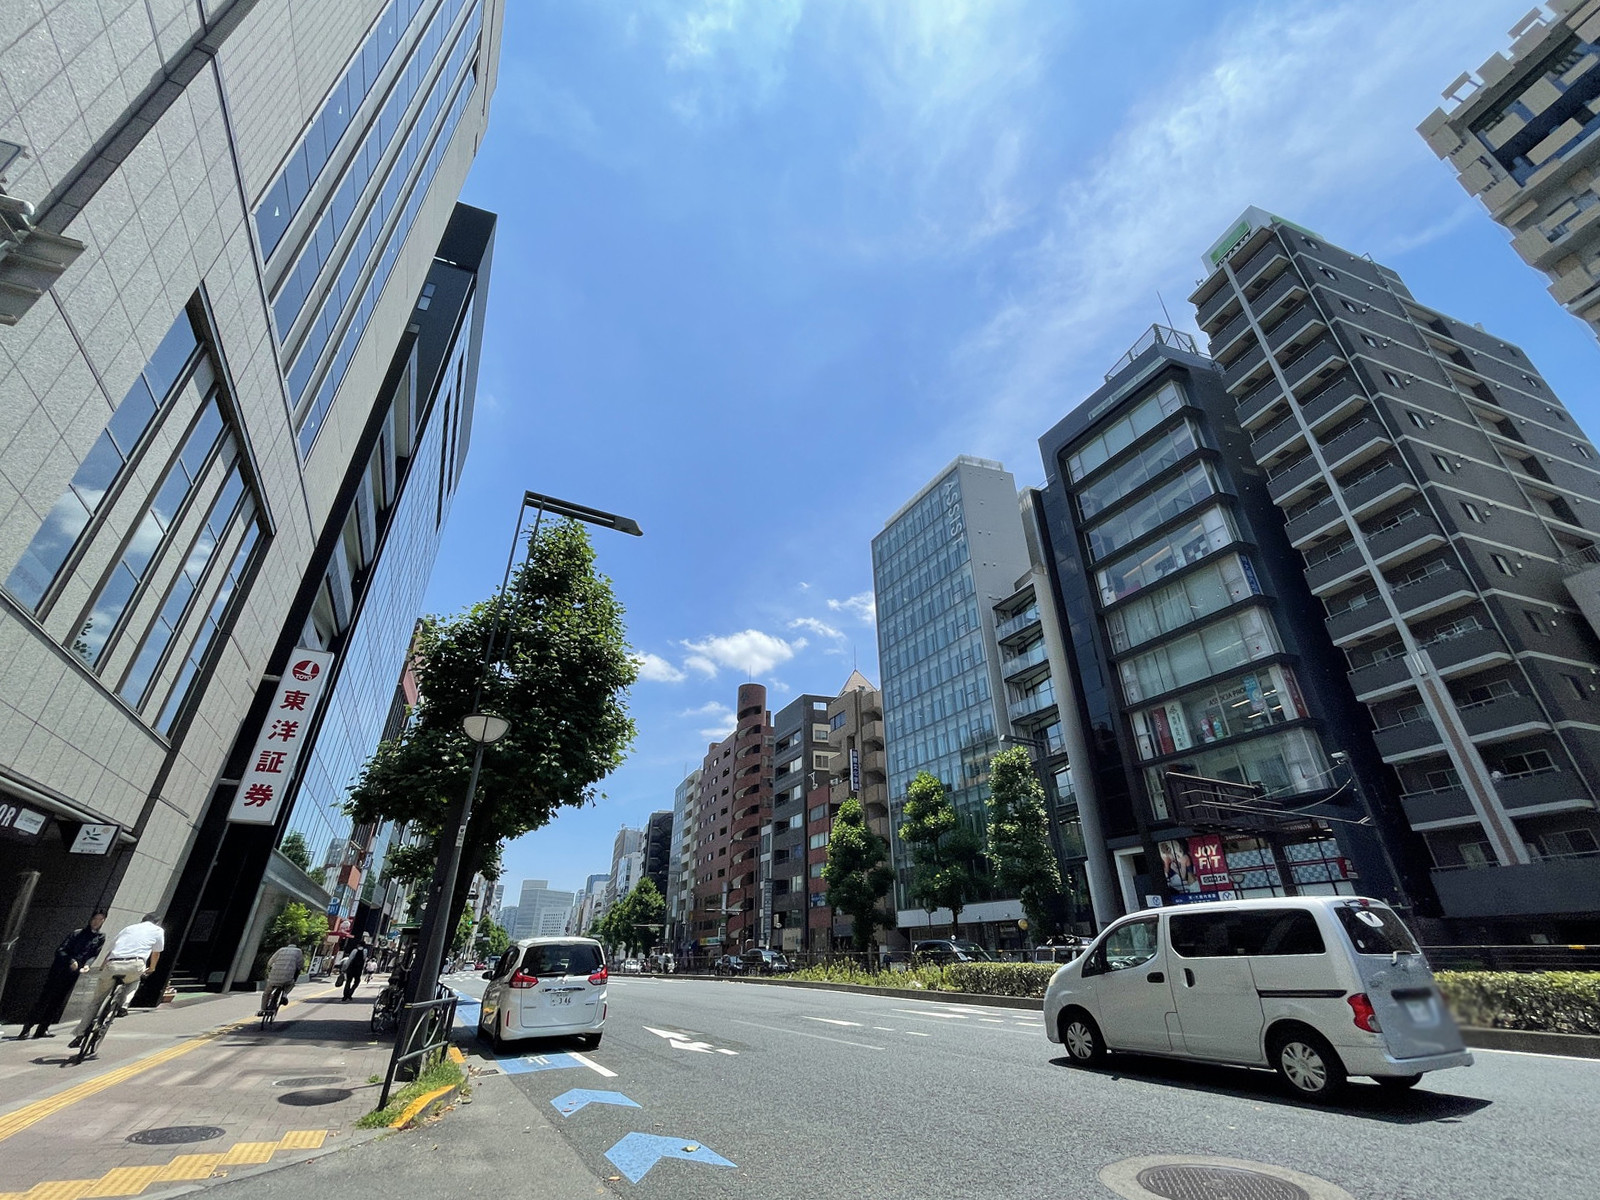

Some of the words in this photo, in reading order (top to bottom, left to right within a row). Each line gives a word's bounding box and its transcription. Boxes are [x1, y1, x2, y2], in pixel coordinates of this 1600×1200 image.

[944, 482, 964, 546] ASSIST
[295, 673, 313, 681] TOYO
[244, 690, 310, 807] 東洋証券
[1194, 844, 1218, 858] JOY
[1198, 856, 1221, 870] FIT
